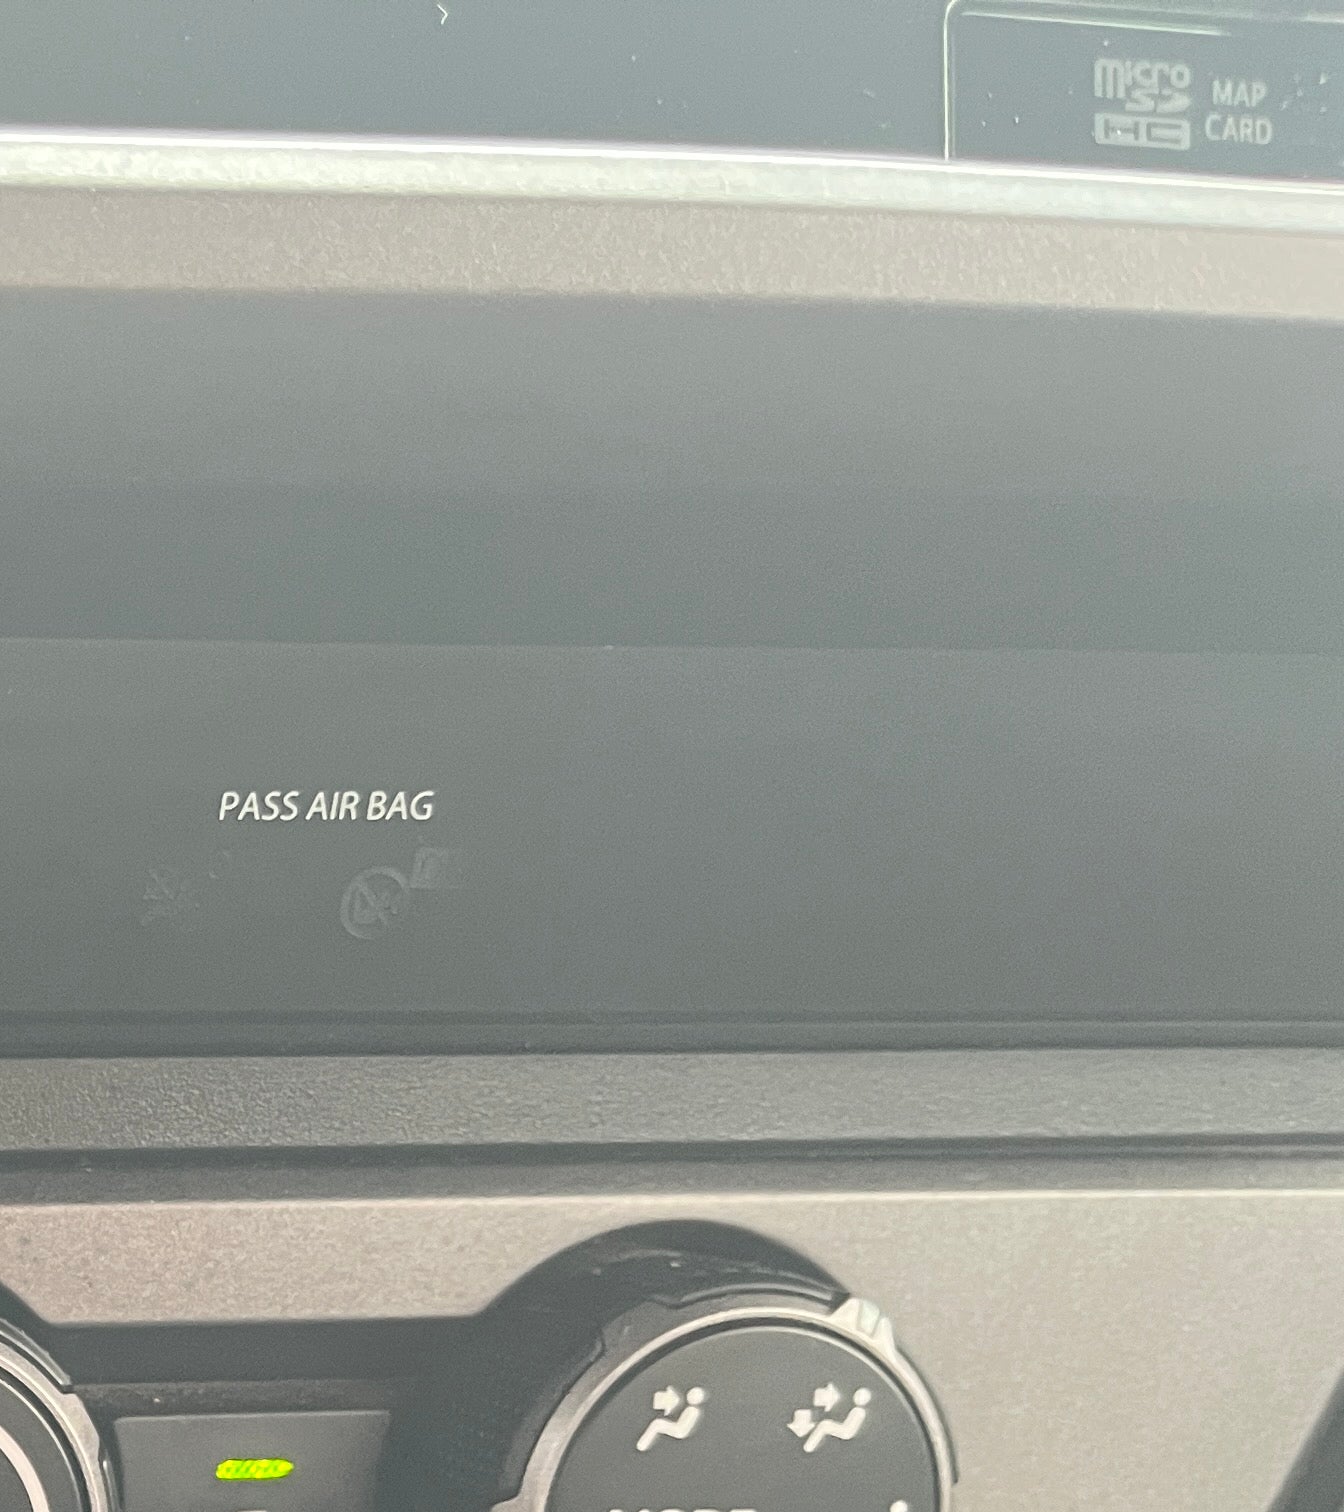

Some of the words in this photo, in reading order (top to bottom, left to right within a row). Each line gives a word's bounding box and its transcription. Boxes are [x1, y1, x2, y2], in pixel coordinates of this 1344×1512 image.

[1211, 80, 1267, 108] MAP
[1205, 113, 1273, 145] CARD
[218, 790, 300, 821] PASS
[305, 790, 361, 821] AIR
[366, 790, 434, 821] BAG
